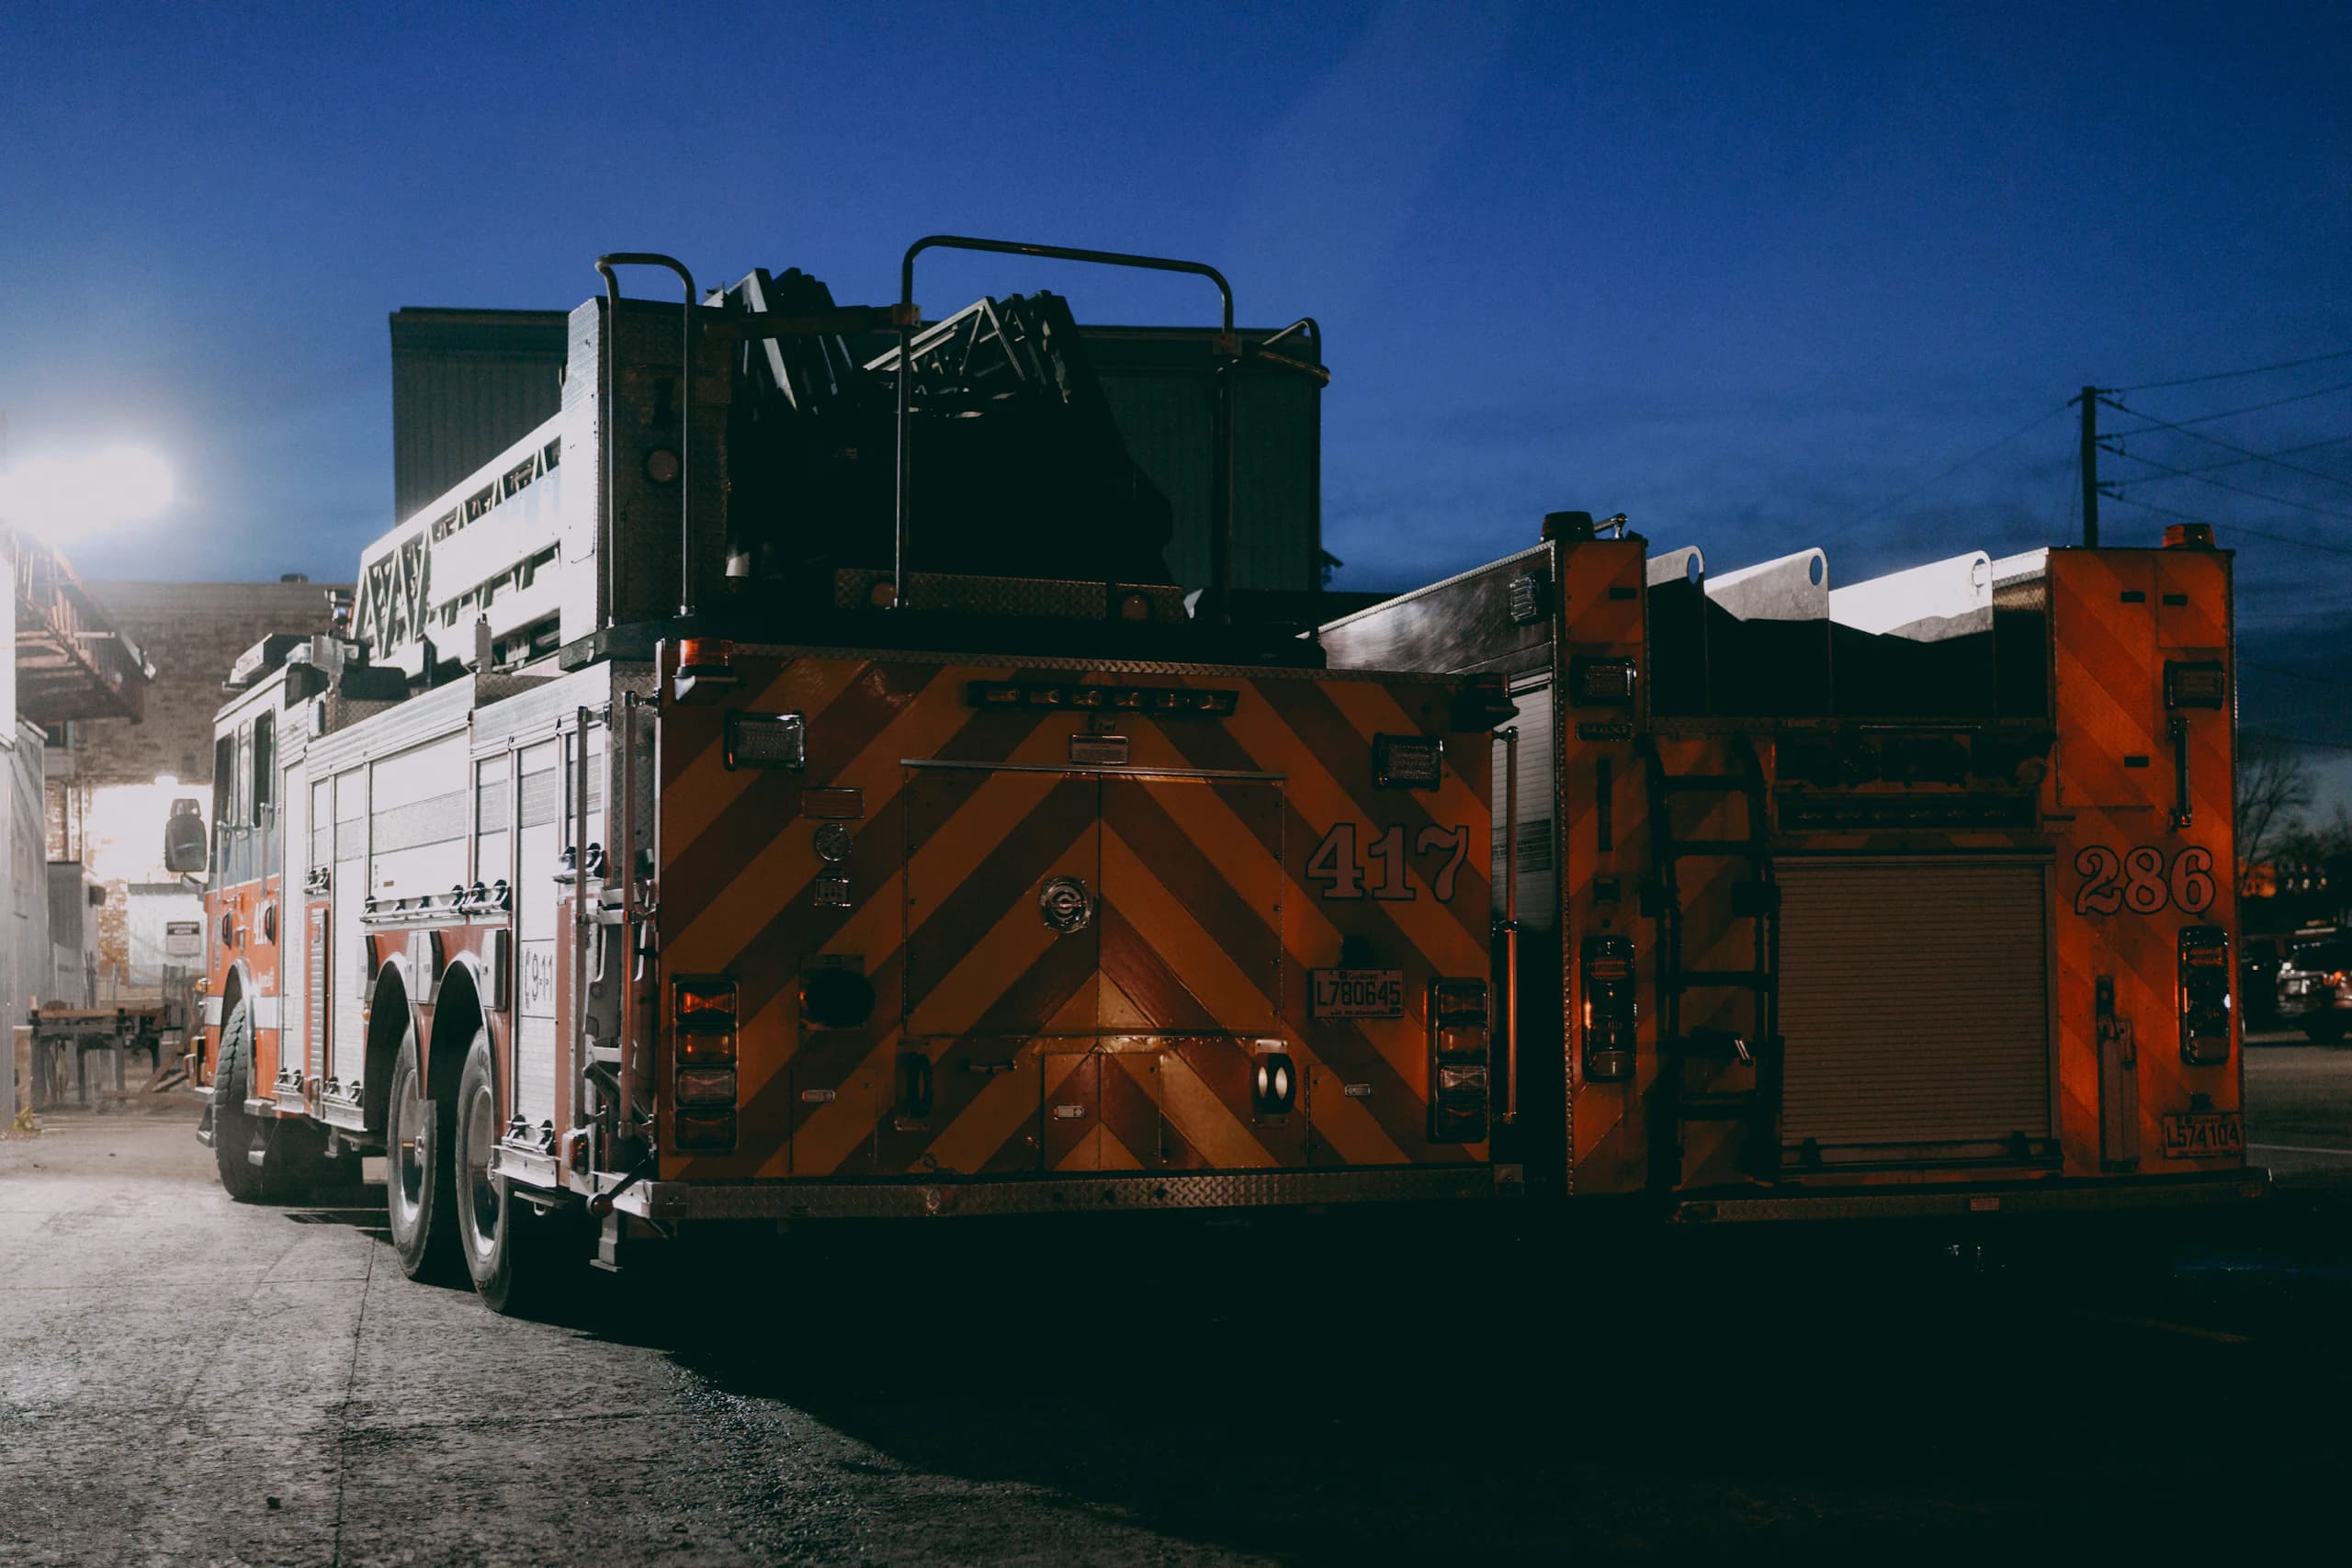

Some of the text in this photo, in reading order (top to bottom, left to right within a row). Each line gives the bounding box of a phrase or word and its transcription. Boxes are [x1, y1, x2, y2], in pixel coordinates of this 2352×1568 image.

[1306, 823, 1469, 904] 417
[2074, 844, 2216, 916] 286
[1317, 981, 1400, 1006] L780645
[2166, 1122, 2240, 1145] L574104
